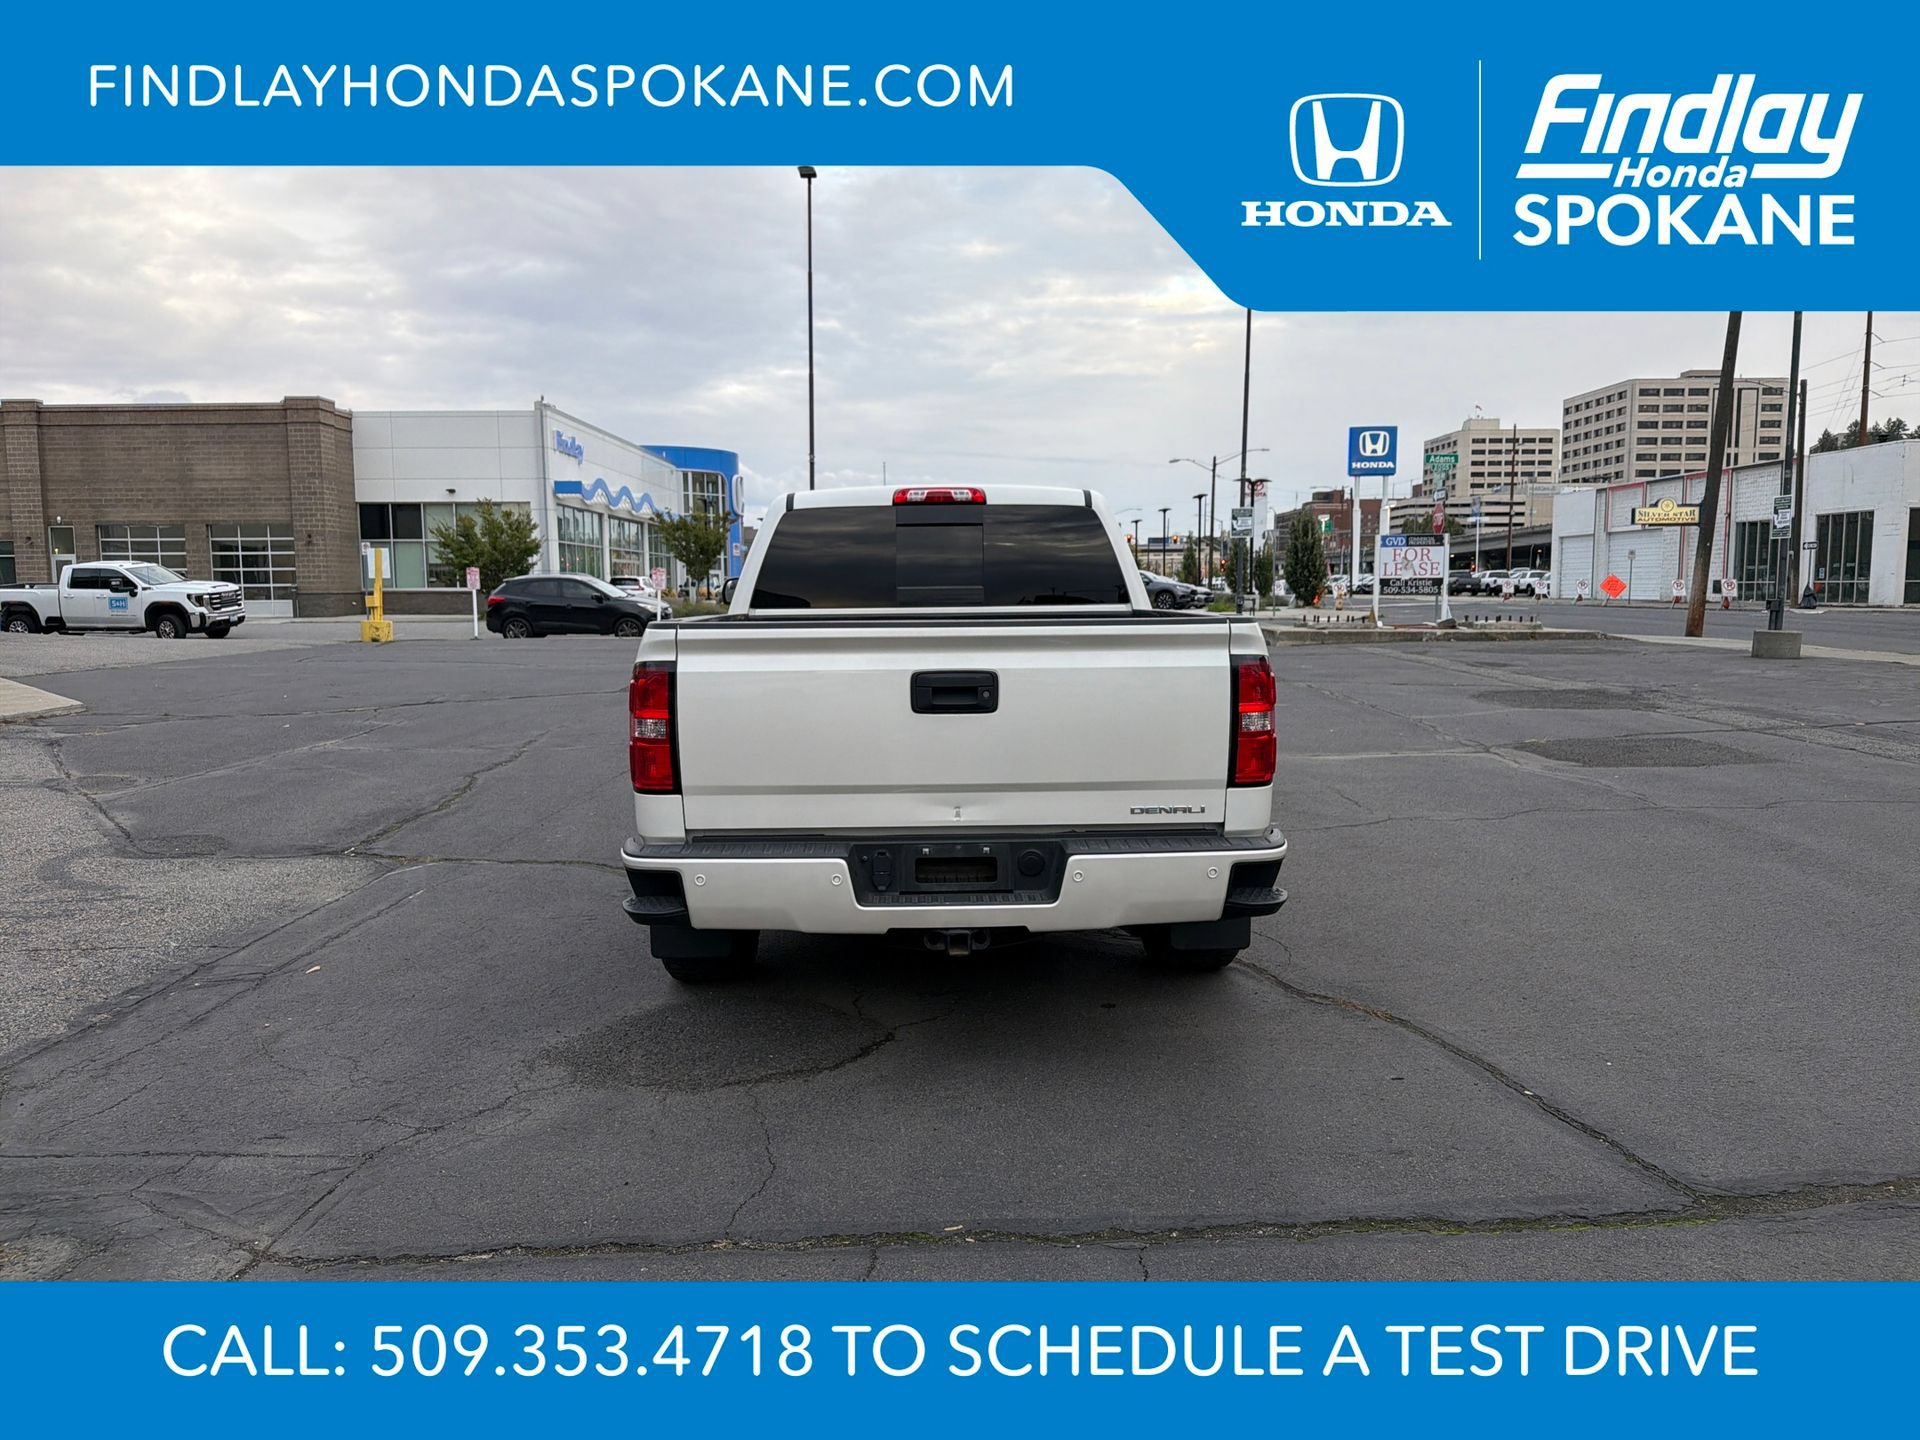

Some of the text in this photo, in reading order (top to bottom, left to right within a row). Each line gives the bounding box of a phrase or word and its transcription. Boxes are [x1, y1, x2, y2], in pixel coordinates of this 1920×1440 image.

[1429, 455, 1456, 463] Adams
[1352, 461, 1395, 469] HONDA
[1638, 509, 1696, 518] SILVER STAR
[1386, 537, 1406, 545] GVD
[1392, 548, 1432, 561] FOR
[1390, 578, 1433, 586] Call Kristie
[1383, 586, 1438, 594] 509-534-5805
[1130, 806, 1205, 815] DENALI
